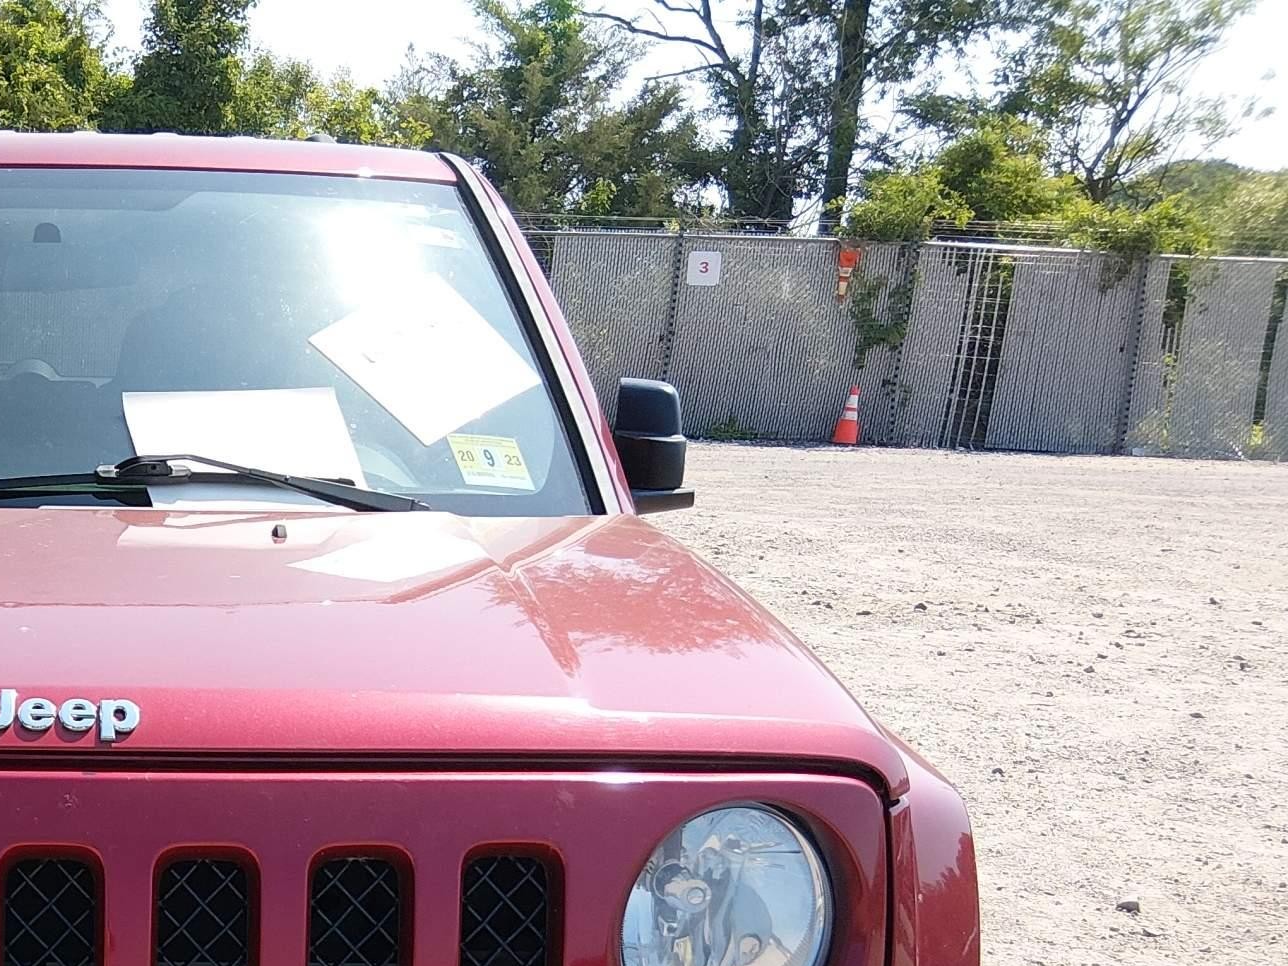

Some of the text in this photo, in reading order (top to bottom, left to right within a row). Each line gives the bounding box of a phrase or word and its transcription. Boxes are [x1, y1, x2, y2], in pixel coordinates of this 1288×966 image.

[699, 261, 709, 273] 3
[457, 449, 523, 468] 20 9 23
